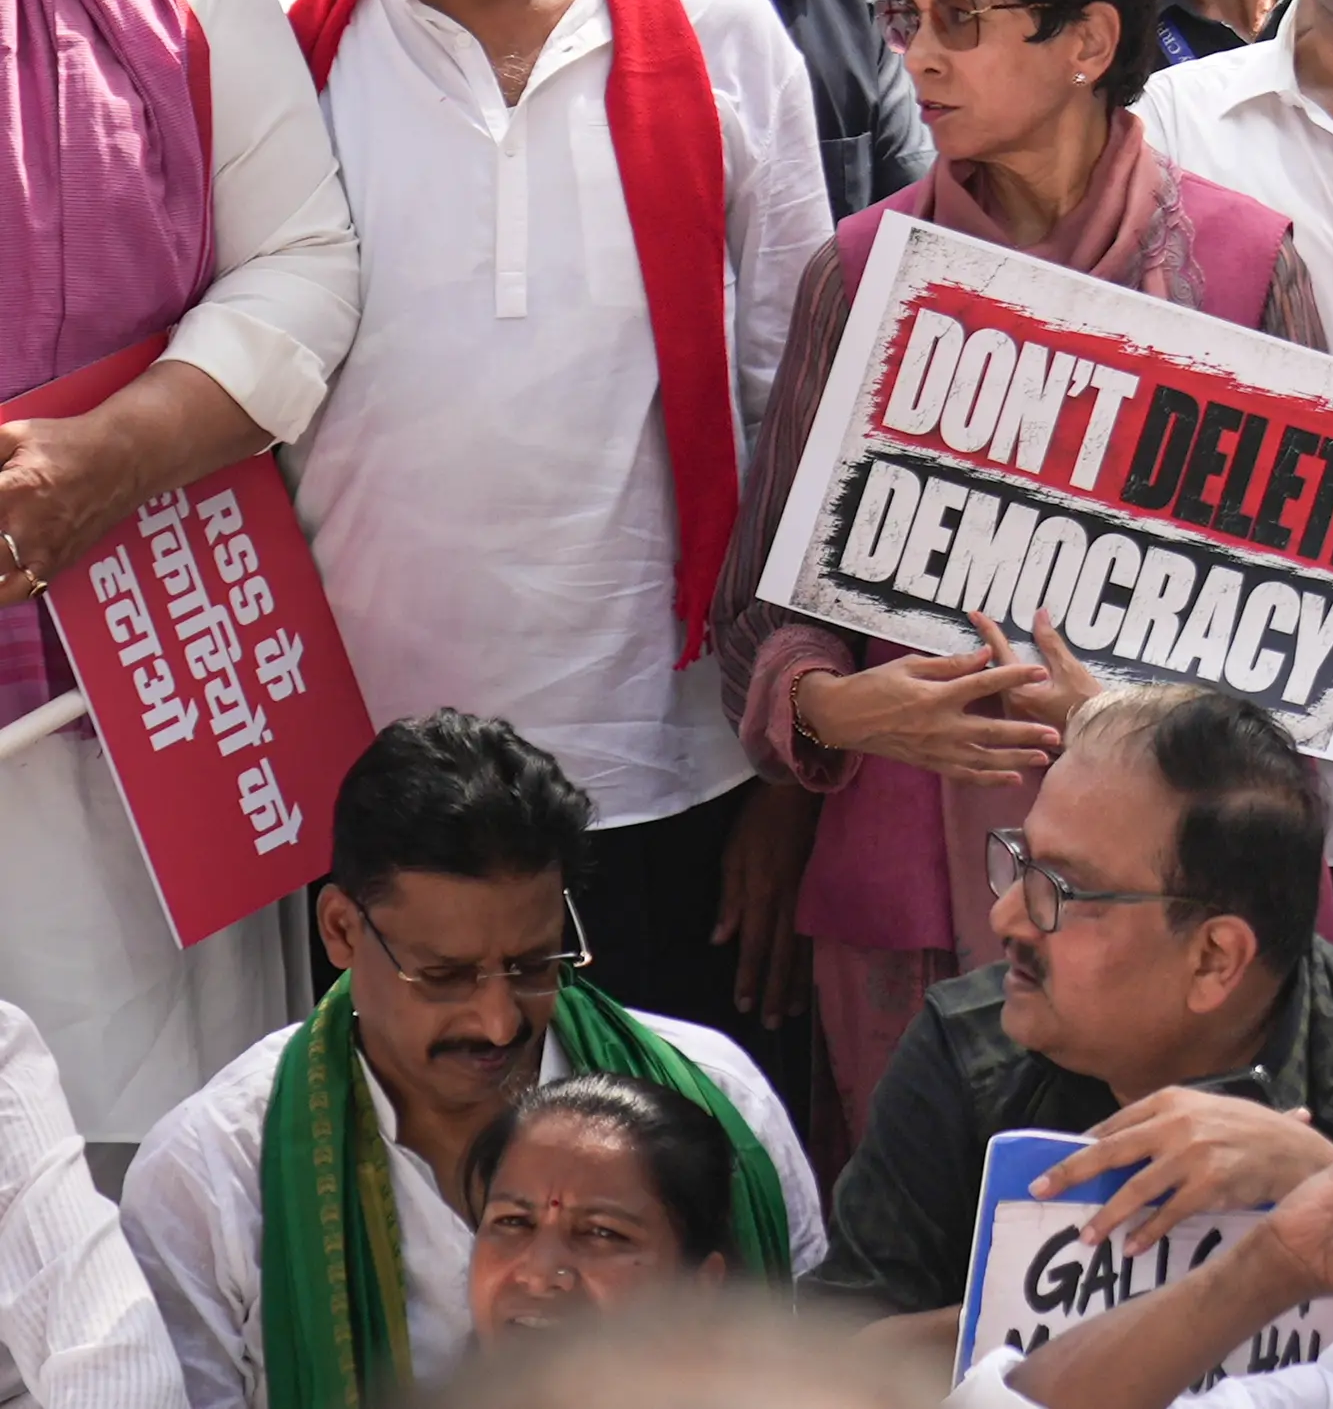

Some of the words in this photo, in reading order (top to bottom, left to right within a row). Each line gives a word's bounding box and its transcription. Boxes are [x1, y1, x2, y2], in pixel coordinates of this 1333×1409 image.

[882, 308, 1139, 490] DON'T
[89, 545, 199, 751] हटाओ
[197, 488, 273, 625] RSS
[254, 628, 305, 701] के
[238, 758, 303, 855] को
